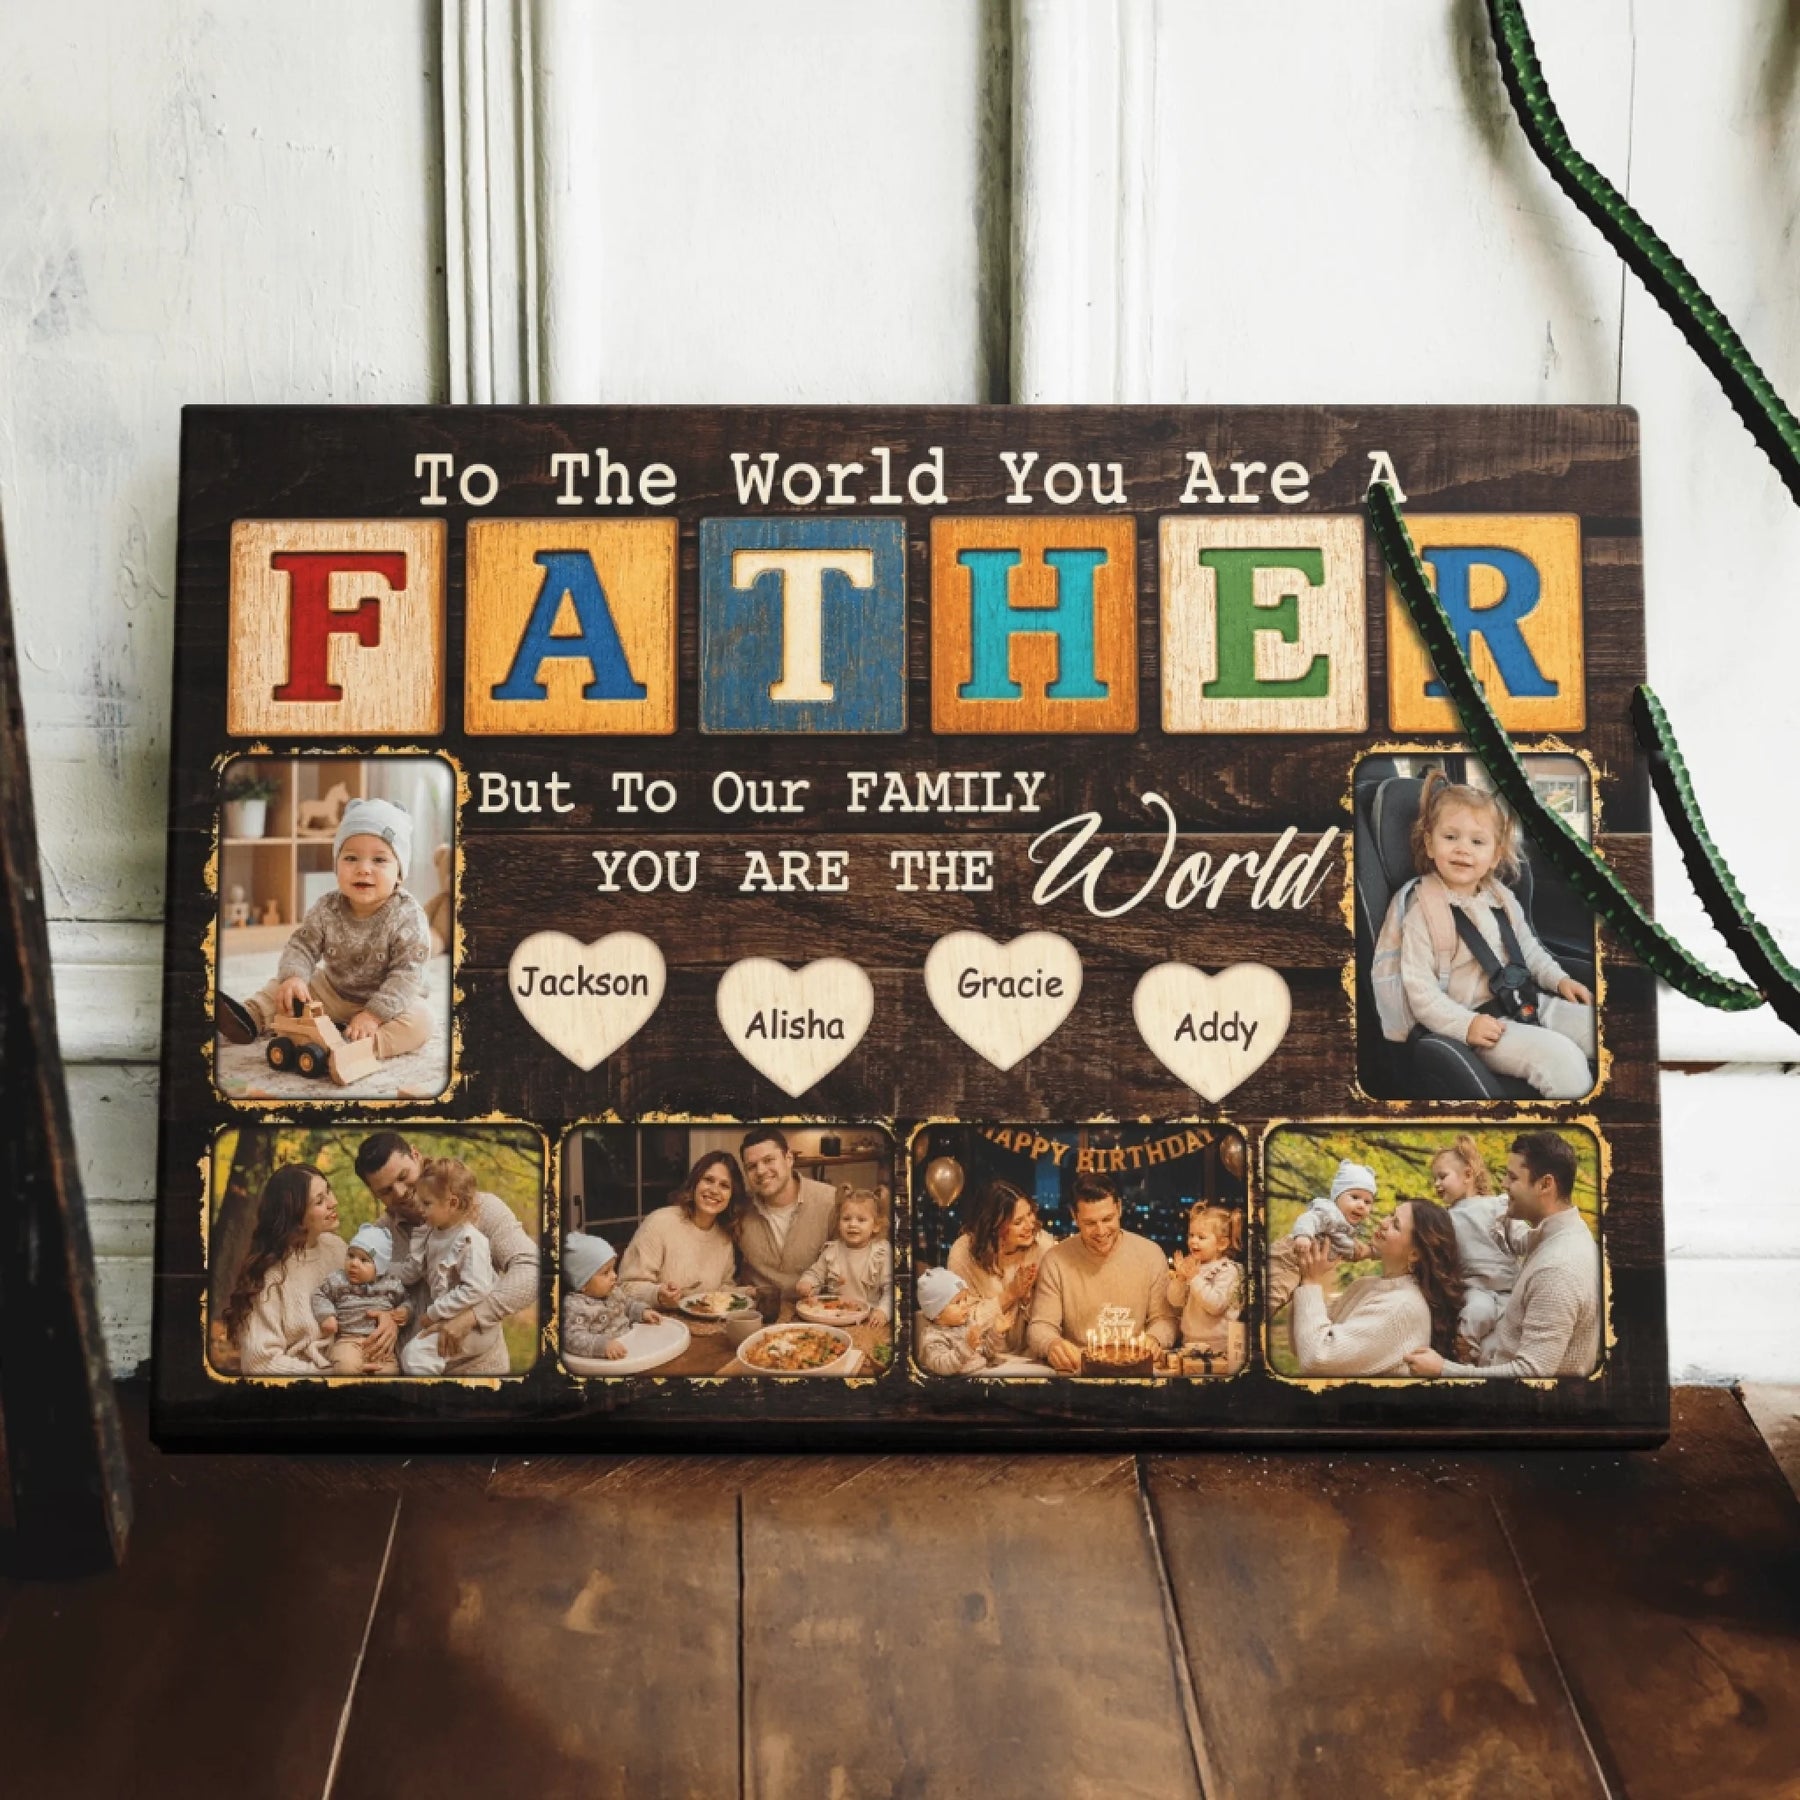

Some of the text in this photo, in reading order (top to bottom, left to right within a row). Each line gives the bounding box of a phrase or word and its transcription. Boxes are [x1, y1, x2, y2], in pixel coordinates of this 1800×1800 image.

[415, 447, 1408, 505] To The World You Are A
[271, 546, 1560, 702] FATHER
[477, 771, 1045, 813] But To Our FAMILY
[593, 792, 1339, 918] YOU ARE THE World
[517, 964, 649, 998] Jackson
[957, 966, 1064, 999] Gracie
[744, 1008, 845, 1040] Alisha
[1174, 1010, 1258, 1052] Addy
[1076, 1127, 1215, 1173] BIRTHDAY
